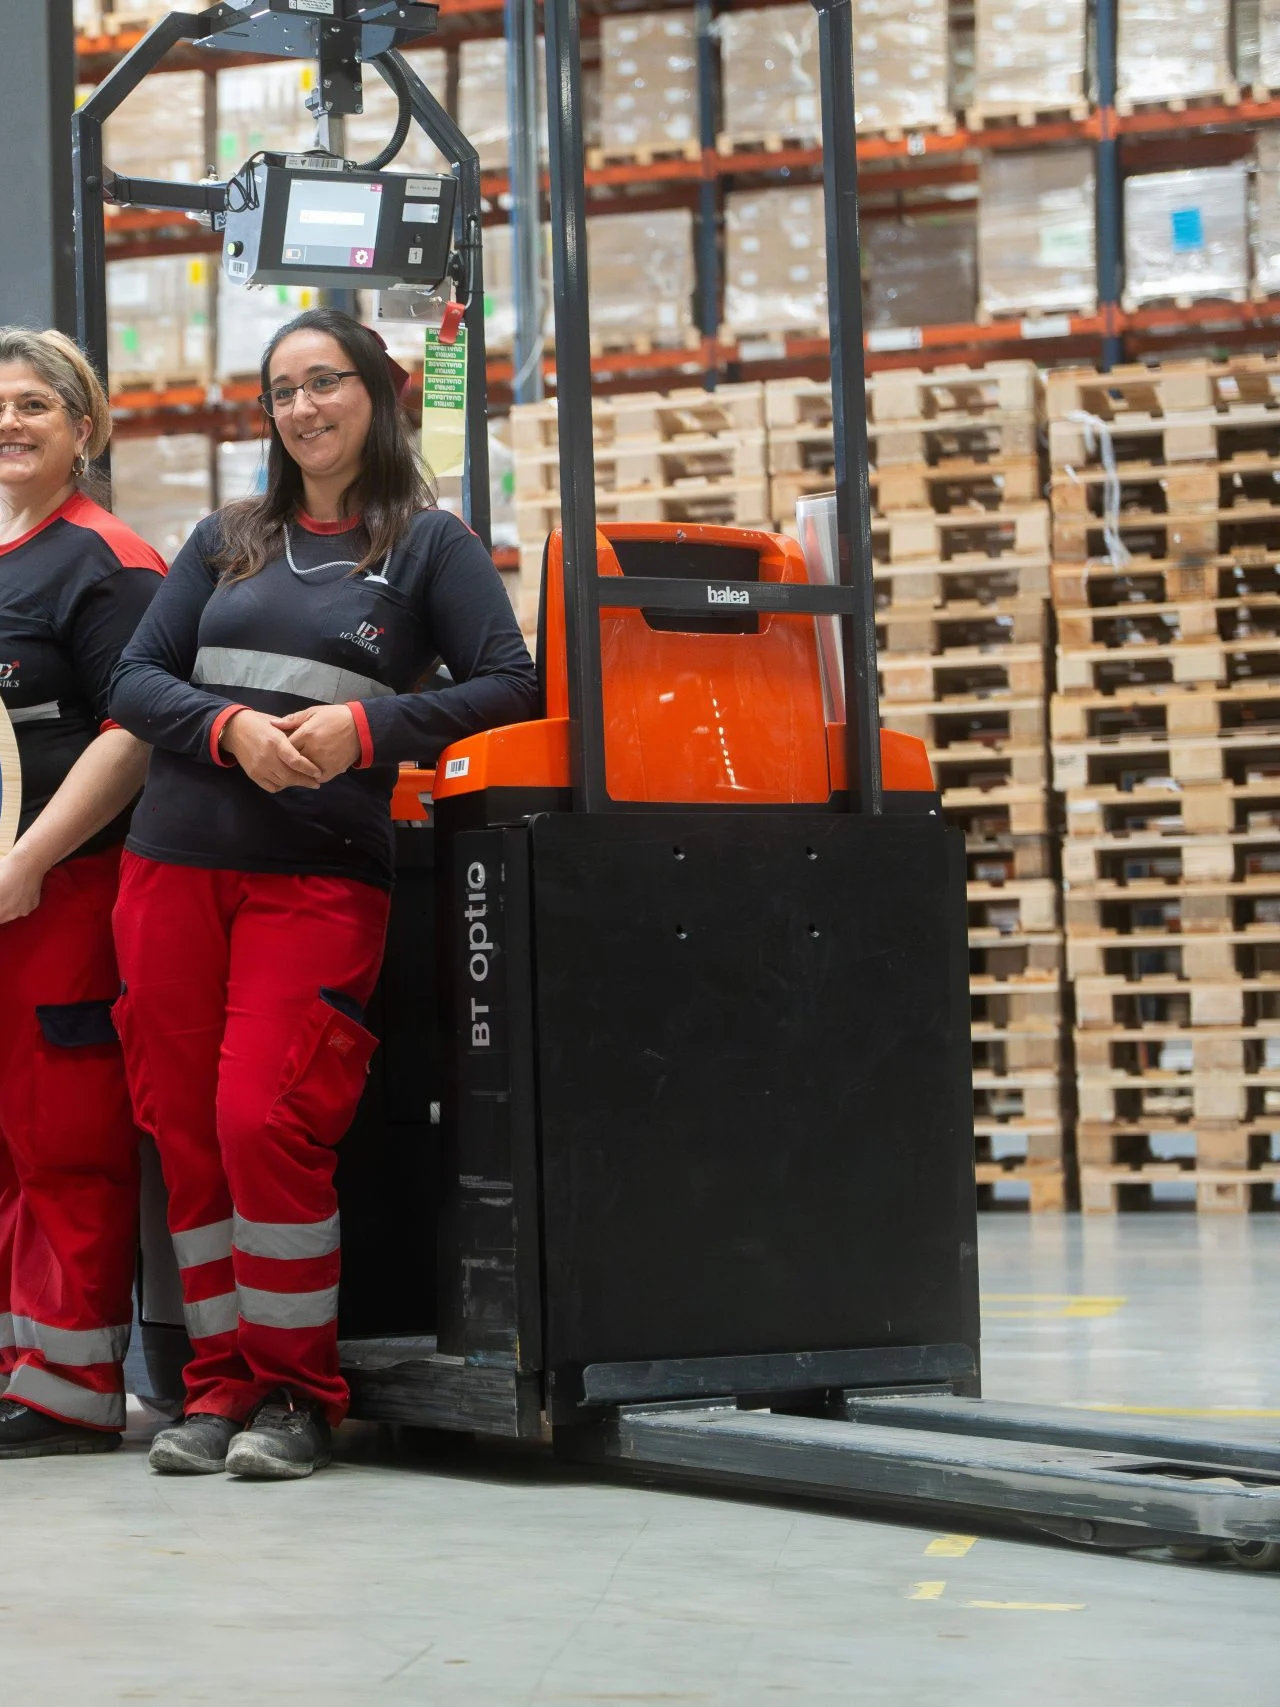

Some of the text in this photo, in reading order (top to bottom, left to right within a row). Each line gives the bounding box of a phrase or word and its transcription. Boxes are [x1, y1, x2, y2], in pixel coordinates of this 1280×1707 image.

[707, 585, 750, 604] balea
[356, 621, 378, 641] ID
[339, 631, 381, 655] LOGISTICS
[471, 997, 490, 1047] BT
